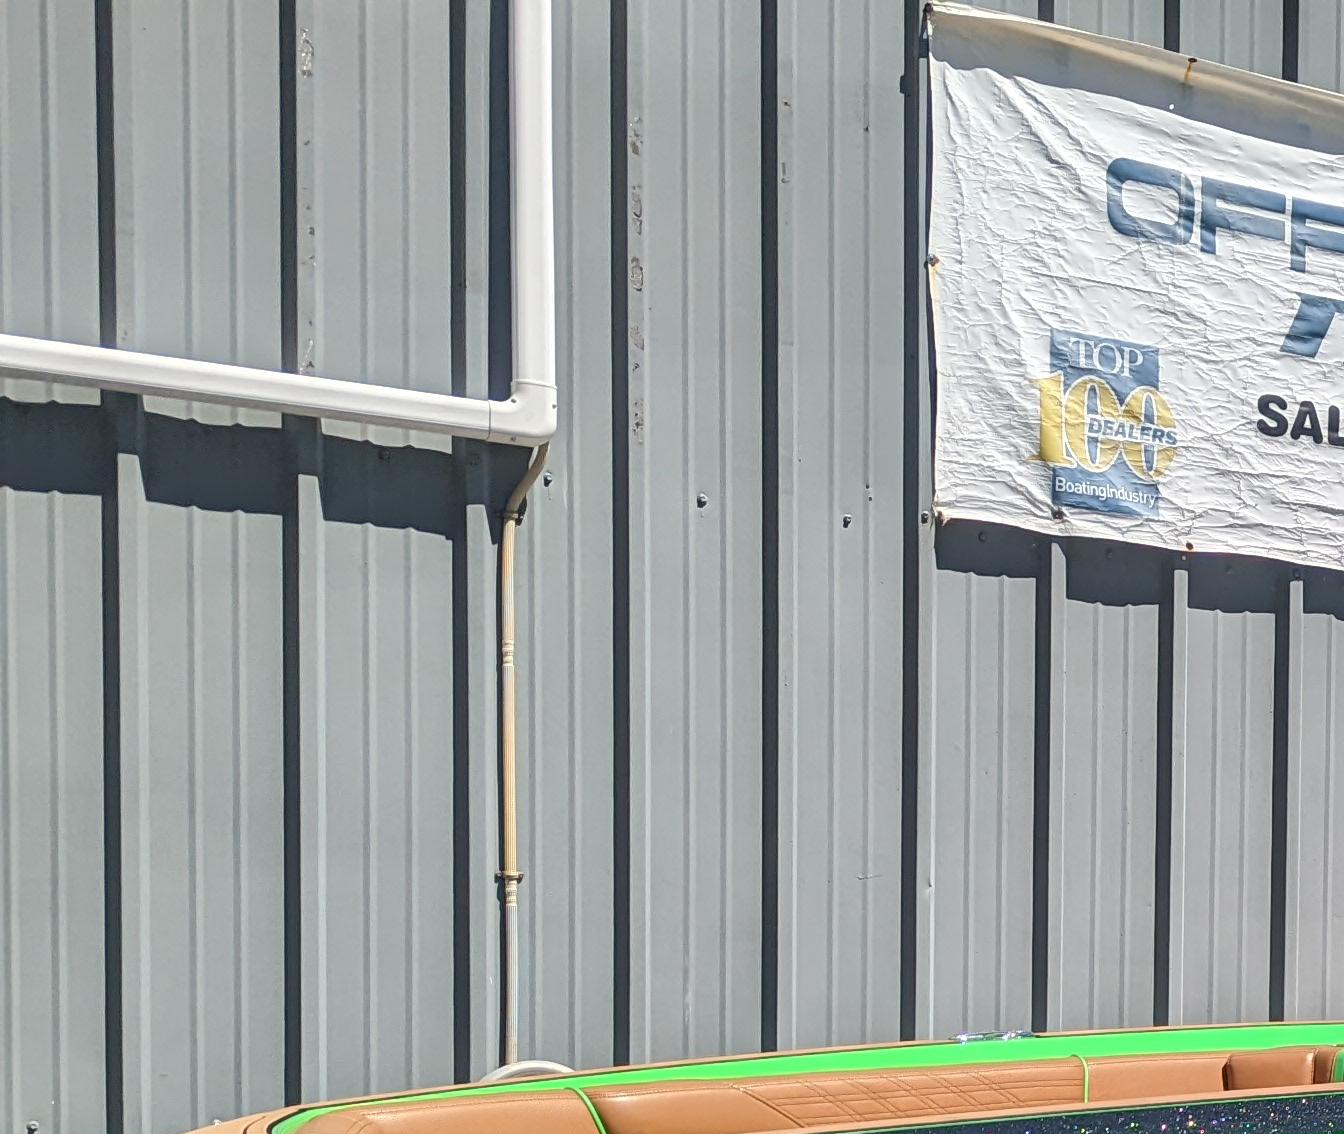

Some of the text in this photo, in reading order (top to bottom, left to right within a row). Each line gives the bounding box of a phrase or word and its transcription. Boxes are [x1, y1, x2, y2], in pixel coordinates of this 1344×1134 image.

[1069, 337, 1144, 377] TOP
[1025, 370, 1178, 482] 100
[1088, 417, 1179, 446] DEALERS
